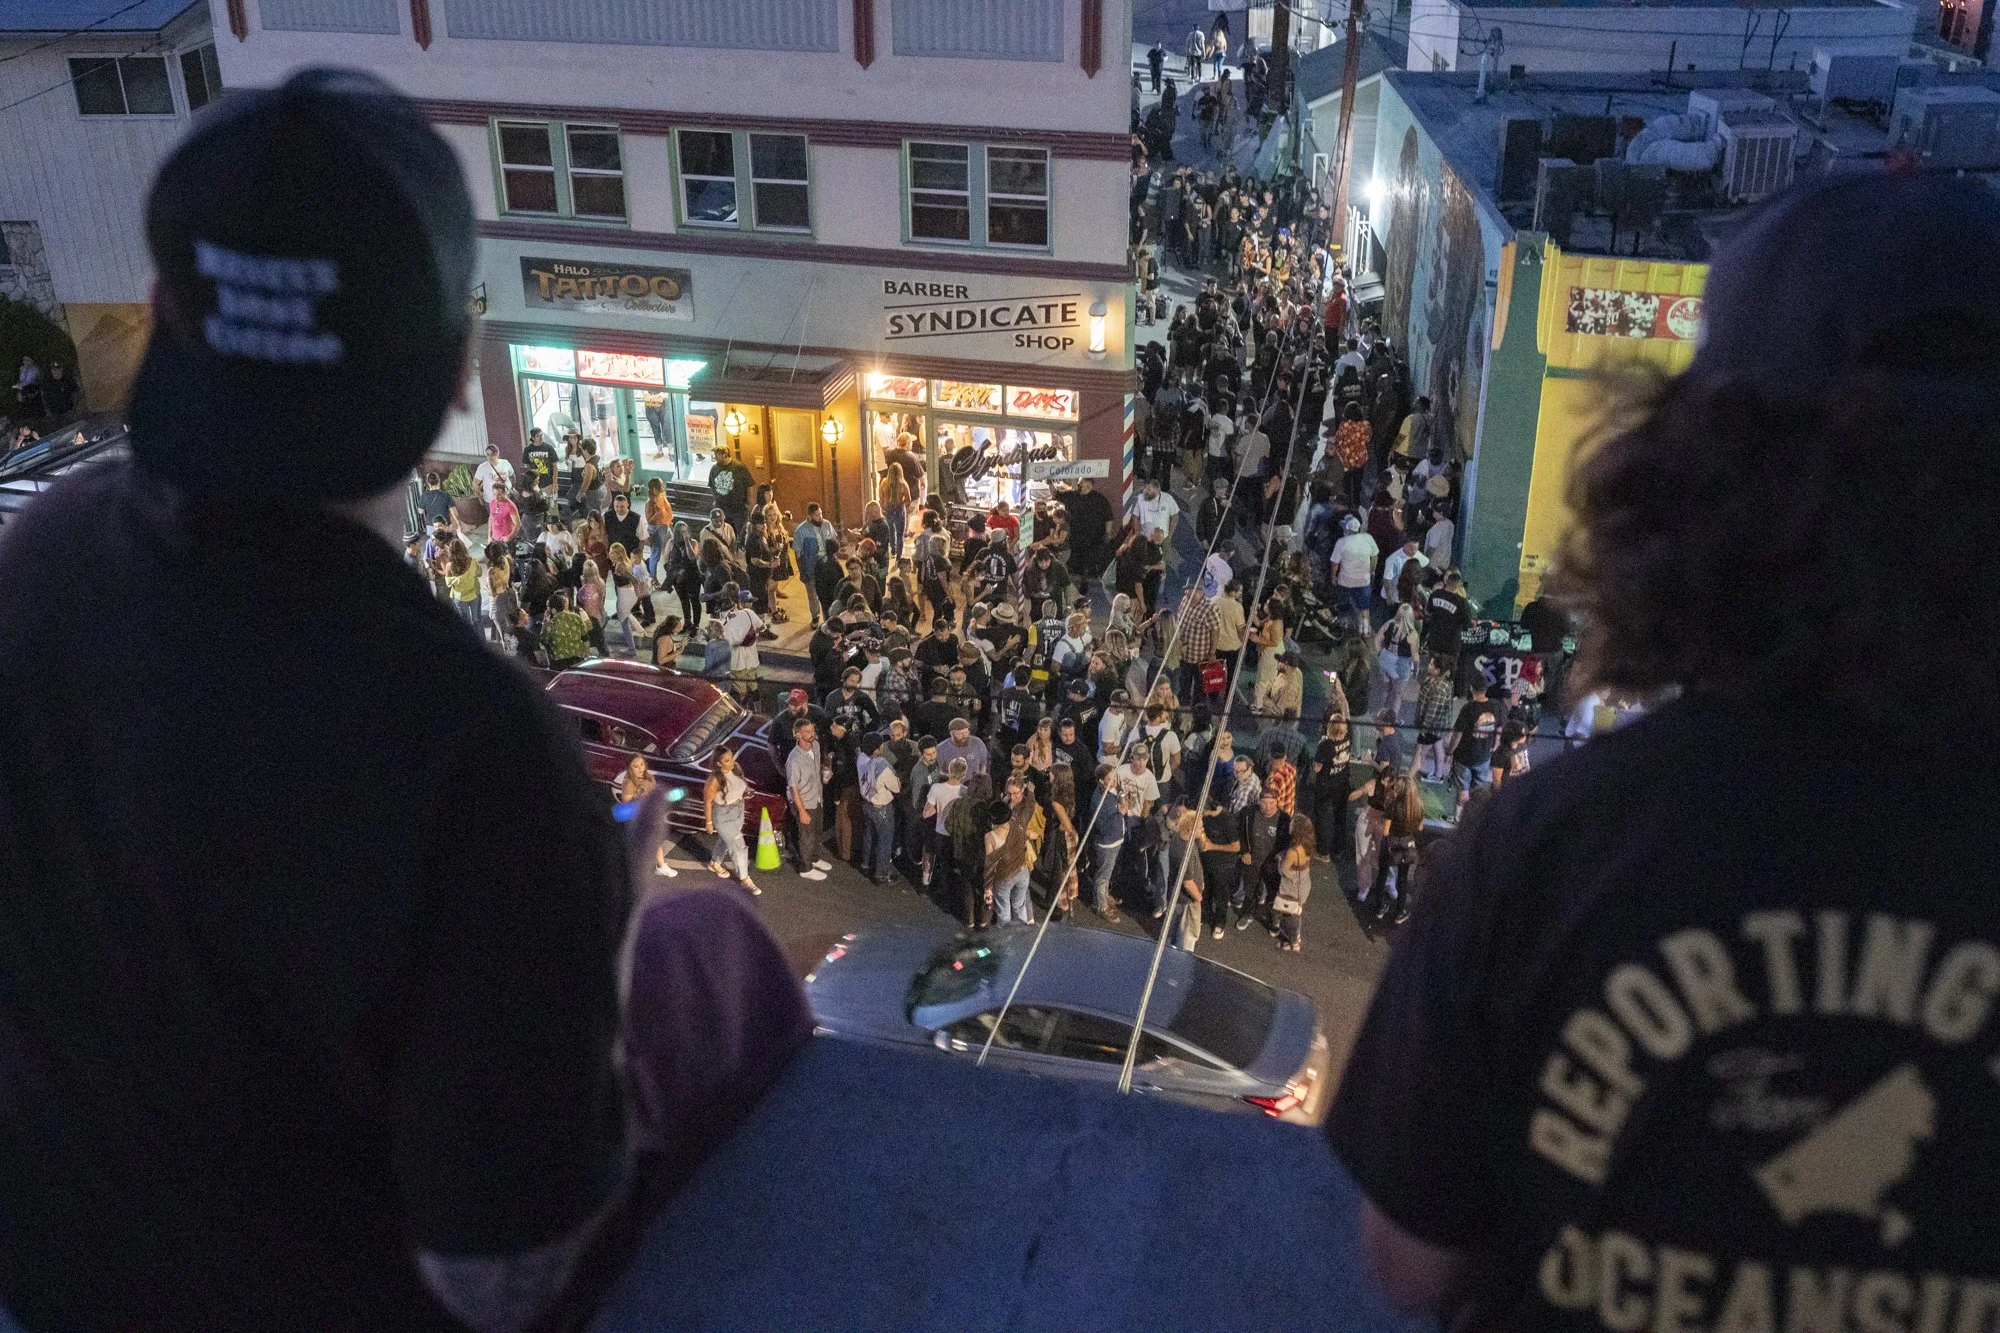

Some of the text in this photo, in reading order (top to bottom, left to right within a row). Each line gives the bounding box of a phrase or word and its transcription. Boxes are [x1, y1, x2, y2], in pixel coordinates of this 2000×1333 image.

[554, 264, 590, 275] HALO
[884, 280, 969, 299] BARBER
[889, 302, 1077, 335] SYNDICATE
[1014, 334, 1075, 350] SHOP
[1013, 390, 1069, 412] DAYS
[1529, 909, 2000, 1185] REPORTING
